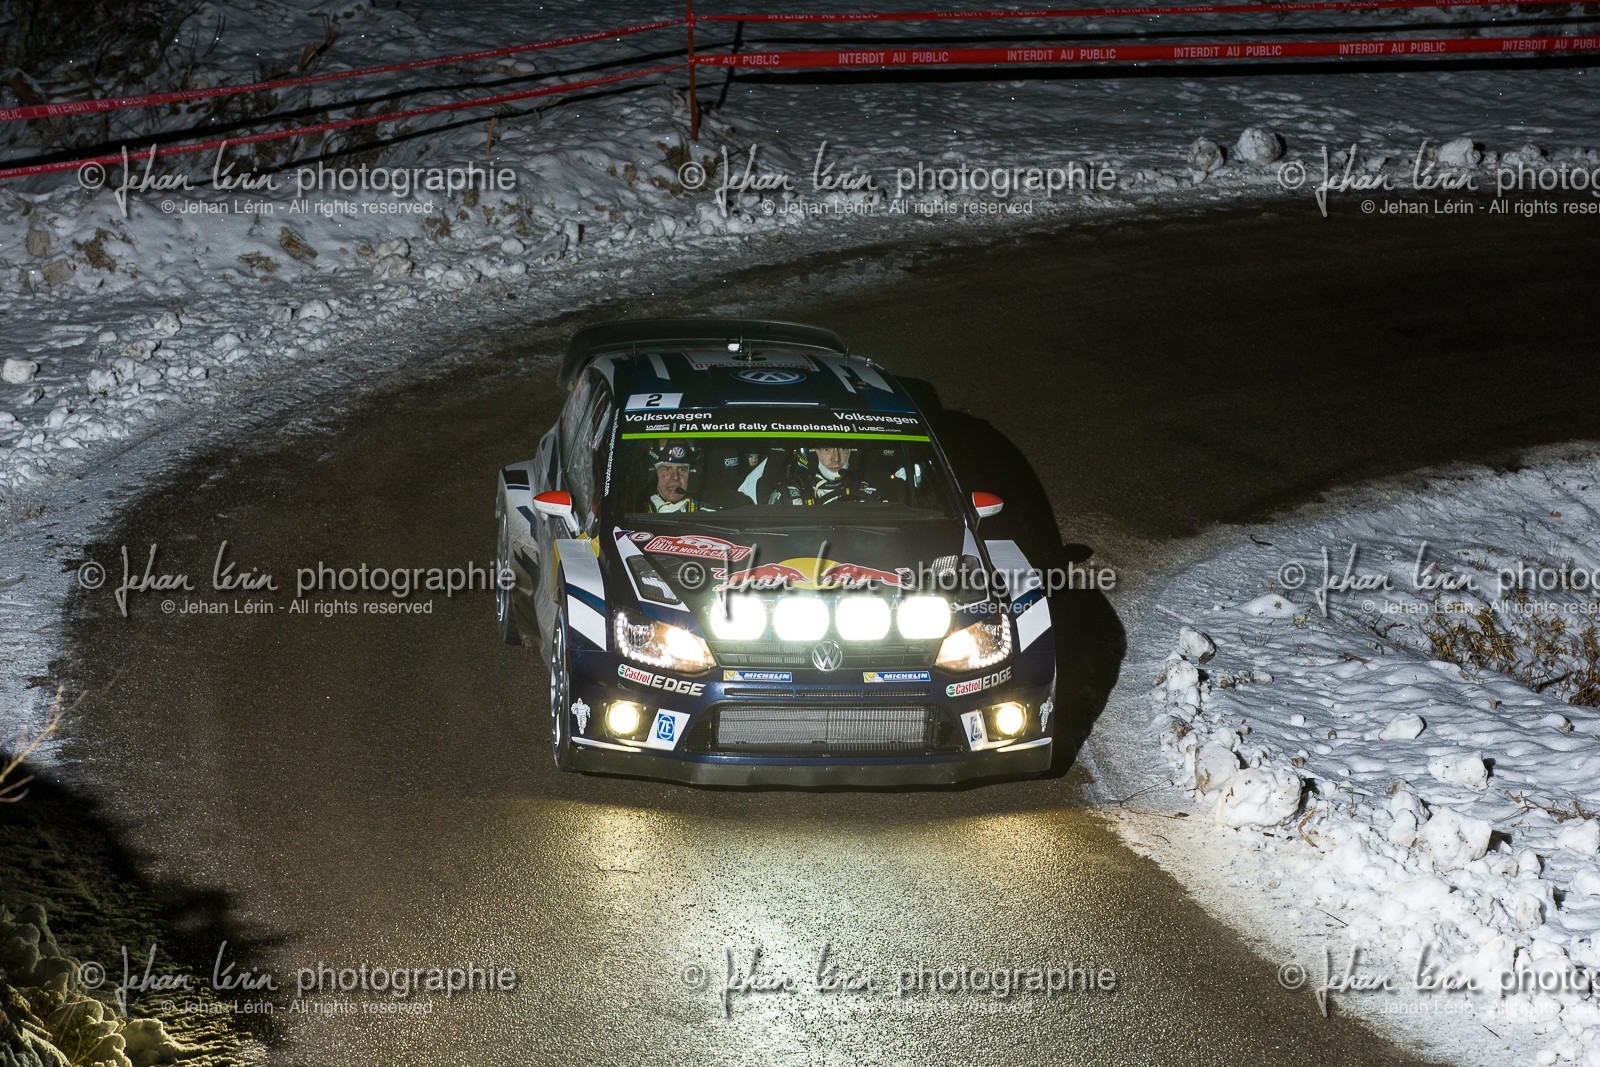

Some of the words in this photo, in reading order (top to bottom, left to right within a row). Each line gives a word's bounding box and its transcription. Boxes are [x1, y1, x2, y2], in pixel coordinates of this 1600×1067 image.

[1174, 47, 1220, 58] INTERDIT
[1226, 46, 1240, 57] AU
[1246, 45, 1282, 56] PUBLIC
[1339, 44, 1385, 55] INTERDIT
[1391, 43, 1405, 54] AU
[1410, 42, 1446, 53] PUBLIC
[1503, 40, 1548, 51] INTERDIT
[1554, 39, 1567, 50] AU
[723, 56, 737, 65] AU
[743, 55, 780, 66] PUBLIC
[839, 53, 886, 64] INTERDIT
[893, 52, 907, 63] AU
[912, 51, 949, 63] PUBLIC
[1007, 50, 1053, 62] INTERDIT
[1060, 49, 1074, 61] AU
[1080, 48, 1116, 60] PUBLIC
[646, 393, 662, 407] 2
[624, 412, 712, 422] Volkswagen
[834, 412, 918, 425] Volkswagen
[679, 423, 698, 431] FIA
[701, 423, 735, 431] World
[739, 423, 767, 432] Rally
[771, 423, 850, 433] Championship
[650, 541, 678, 552] RALLYE
[625, 667, 652, 685] Castrol
[651, 675, 706, 697] EDGE
[743, 672, 790, 681] MICHELIN
[884, 672, 928, 681] MICHELIN
[955, 681, 981, 695] Castrol
[982, 666, 1012, 689] EDGE
